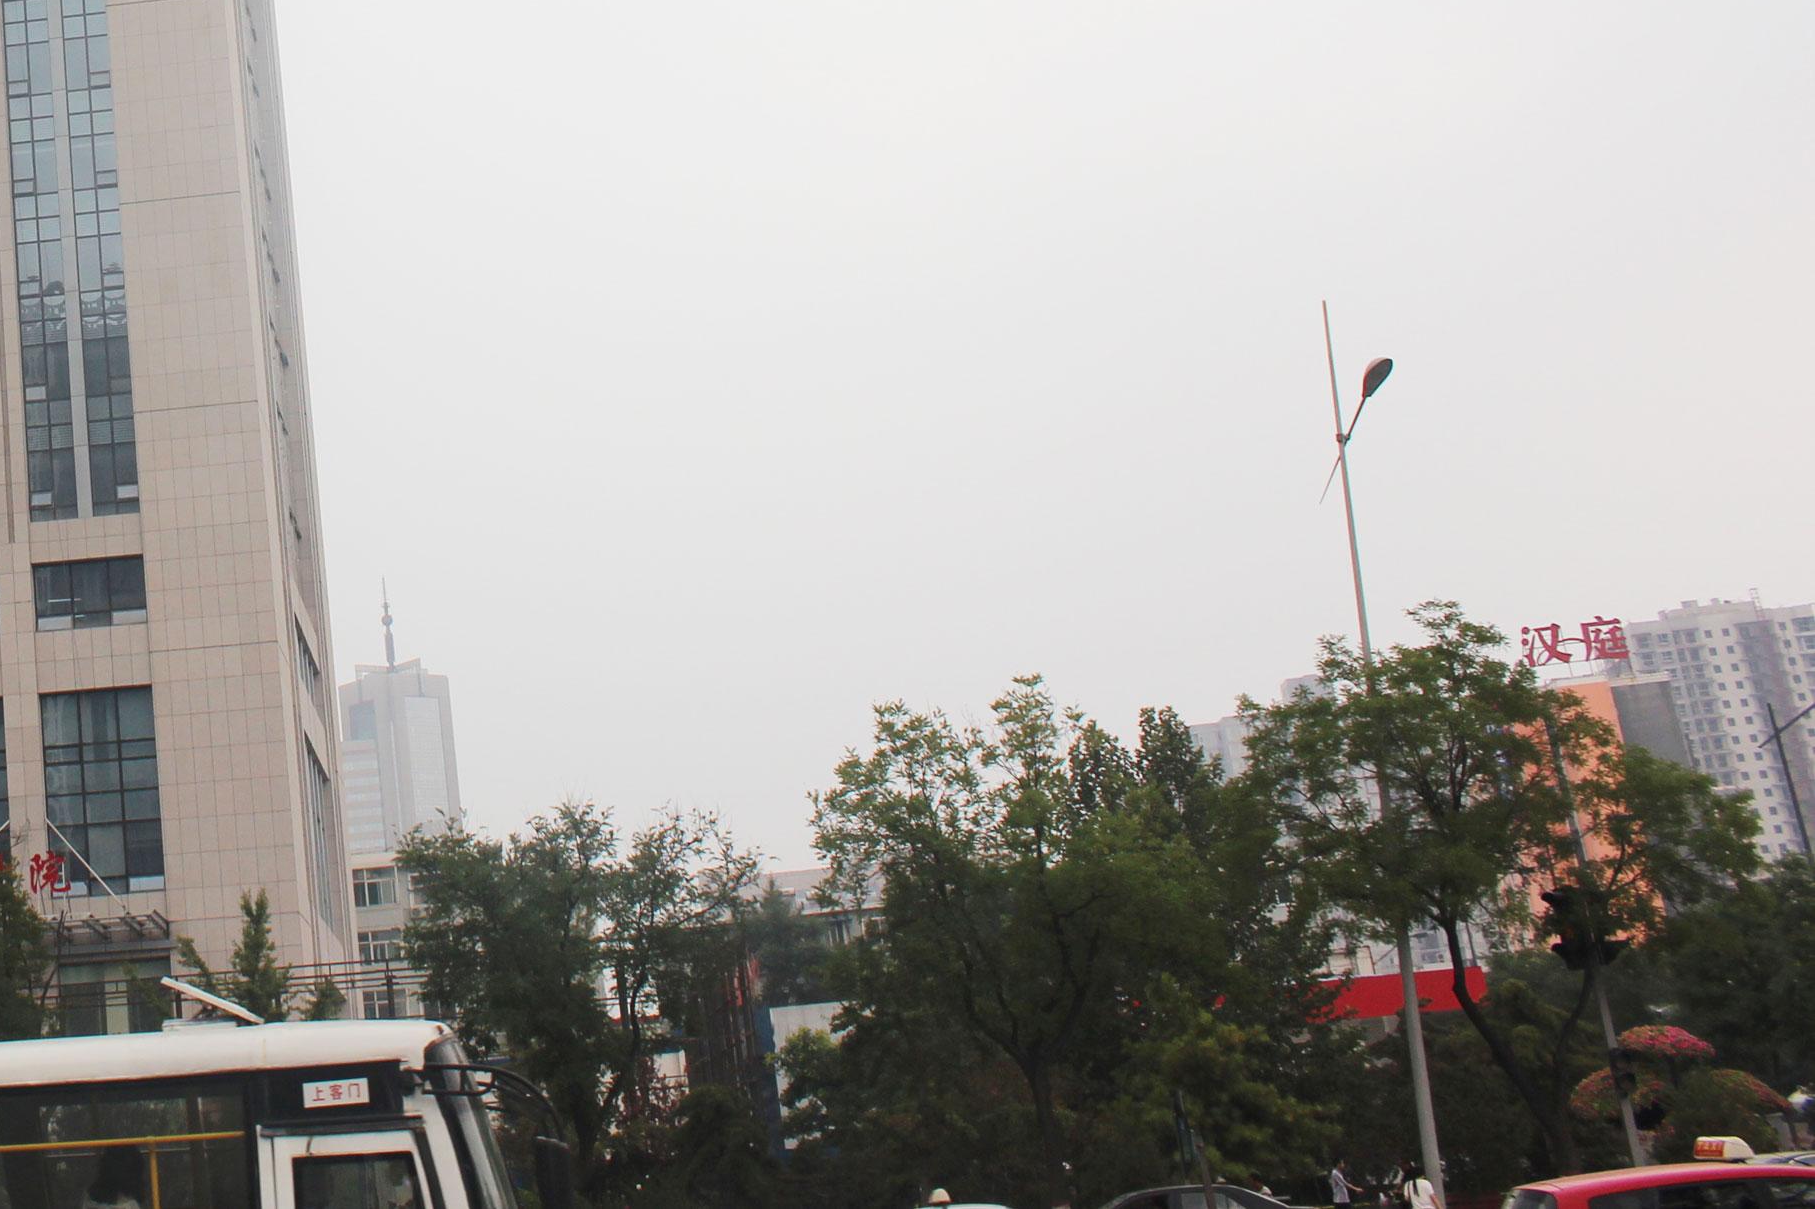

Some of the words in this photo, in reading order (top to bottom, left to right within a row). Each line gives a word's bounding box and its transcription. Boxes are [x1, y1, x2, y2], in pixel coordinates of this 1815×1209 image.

[1521, 615, 1630, 667] 汉庭
[312, 1083, 361, 1102] 上客门
